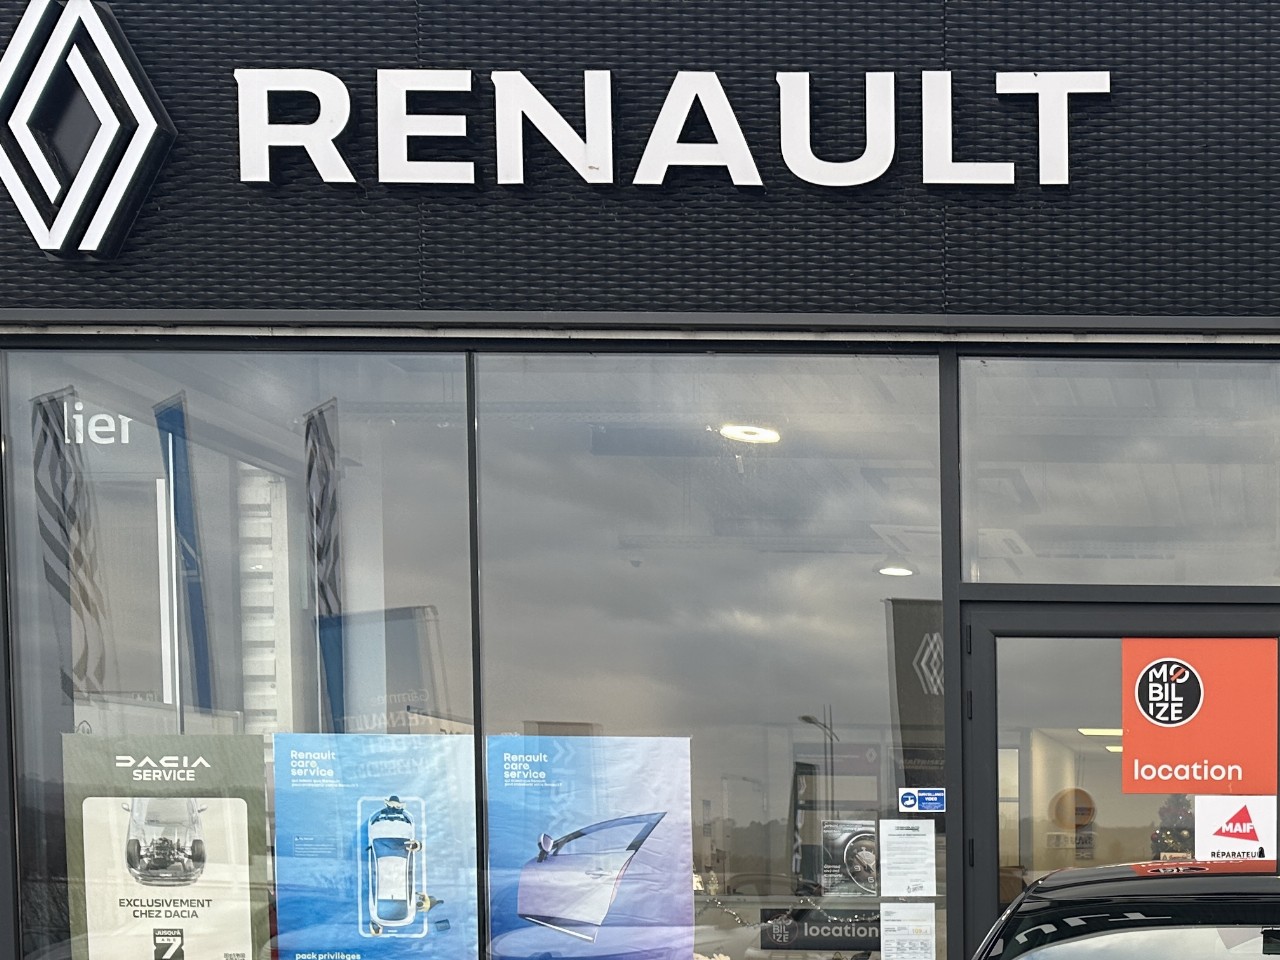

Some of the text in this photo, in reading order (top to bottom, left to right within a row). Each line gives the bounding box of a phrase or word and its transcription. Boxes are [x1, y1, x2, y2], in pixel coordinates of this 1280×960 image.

[234, 67, 1111, 187] RENAULT
[290, 749, 336, 760] Renault
[503, 752, 549, 763] Renault
[115, 755, 211, 768] DACIA
[290, 760, 318, 769] care
[503, 762, 530, 770] care
[132, 769, 196, 781] SERVICE
[290, 767, 334, 777] service
[503, 769, 546, 779] service
[1133, 759, 1243, 781] location
[1221, 822, 1255, 834] MAIF
[1210, 849, 1261, 859] RÉPARATEU
[118, 898, 213, 908] EXCLUSIVEMENT
[132, 909, 199, 919] CHEZ DACIA
[804, 922, 879, 938] location
[295, 952, 317, 960] pack
